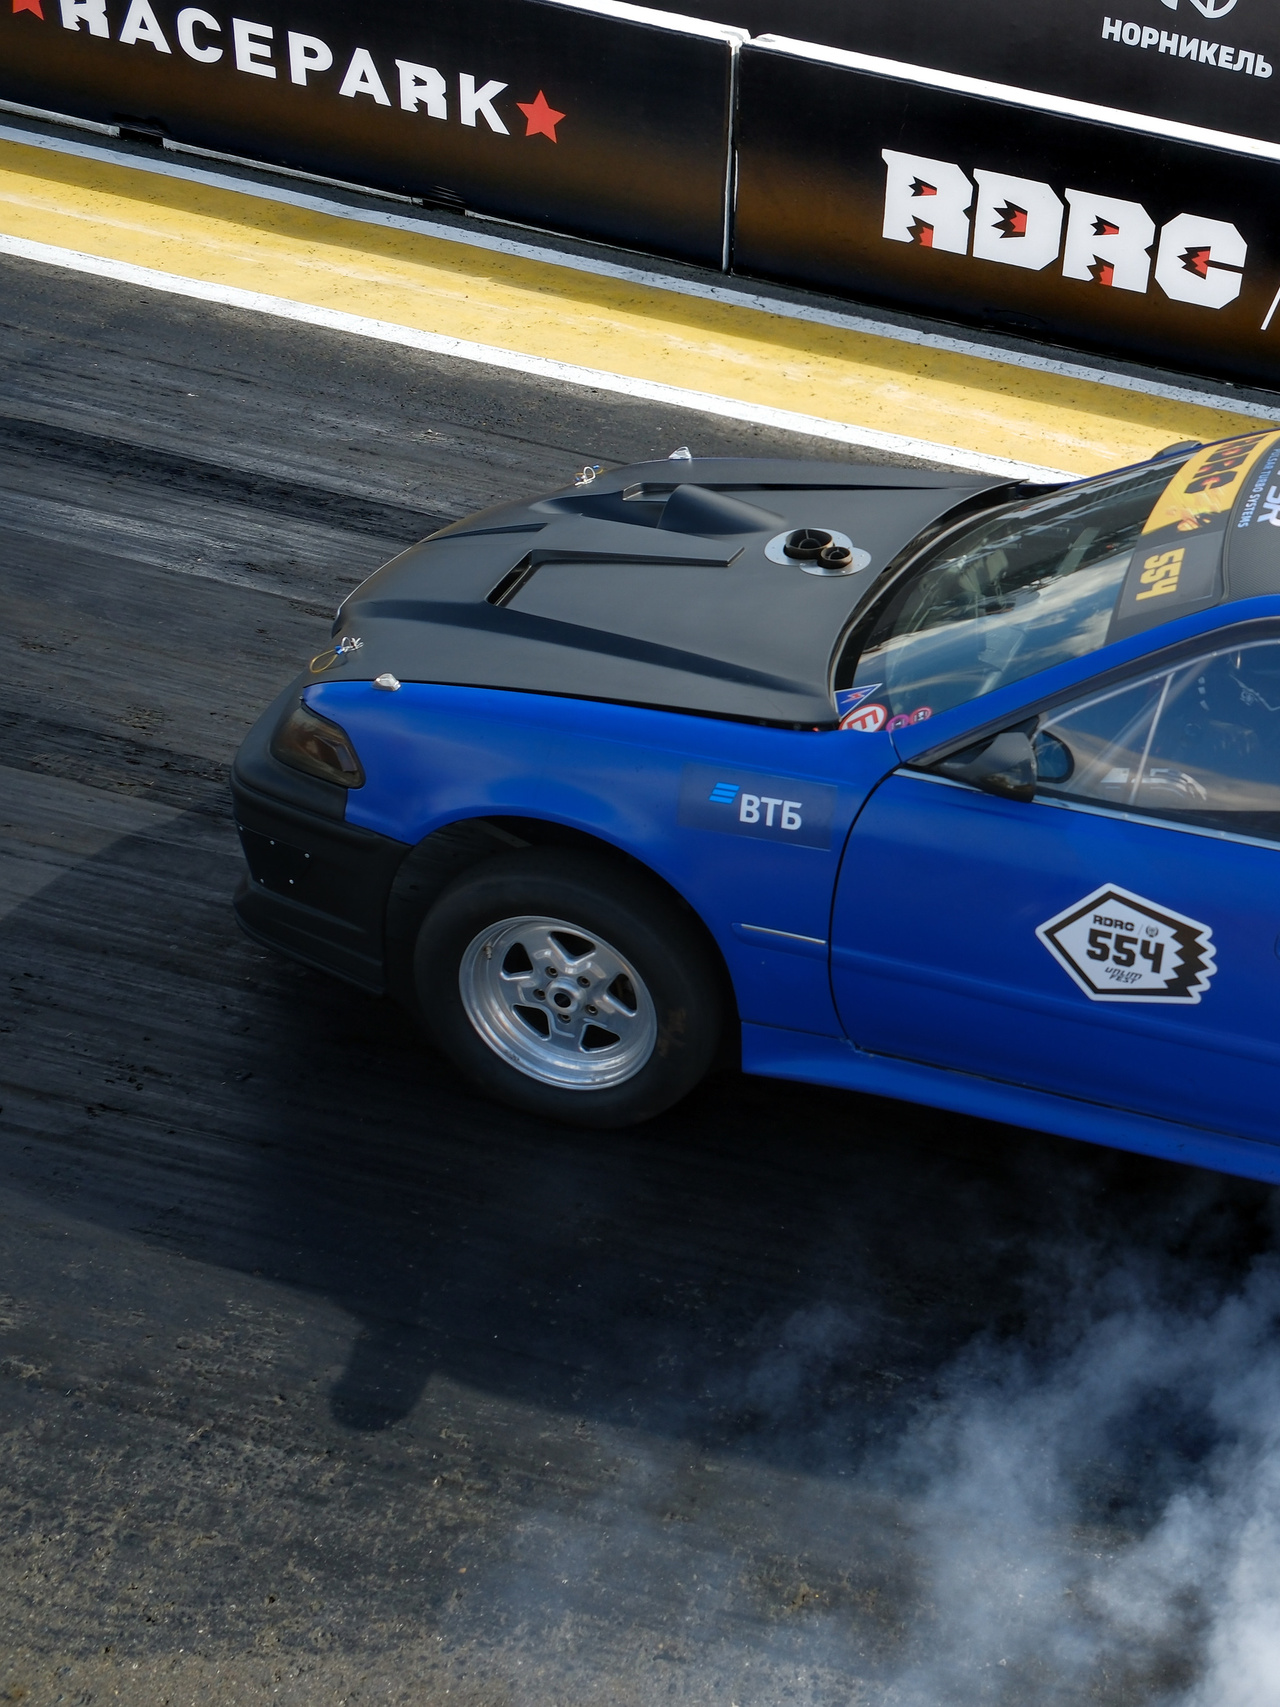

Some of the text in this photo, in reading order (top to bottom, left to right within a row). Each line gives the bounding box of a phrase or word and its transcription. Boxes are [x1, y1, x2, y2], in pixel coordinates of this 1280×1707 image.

[59, 0, 511, 135] RACEPARK
[1101, 16, 1273, 79] НОРНИКЕЛЬ
[881, 148, 1249, 310] RDRC
[1252, 470, 1272, 493] TURBO
[1237, 493, 1261, 528] SYSTEMS
[1136, 547, 1186, 601] 554
[739, 793, 803, 831] ВТБ
[1093, 914, 1135, 932] RDRC
[1086, 927, 1165, 974] 554
